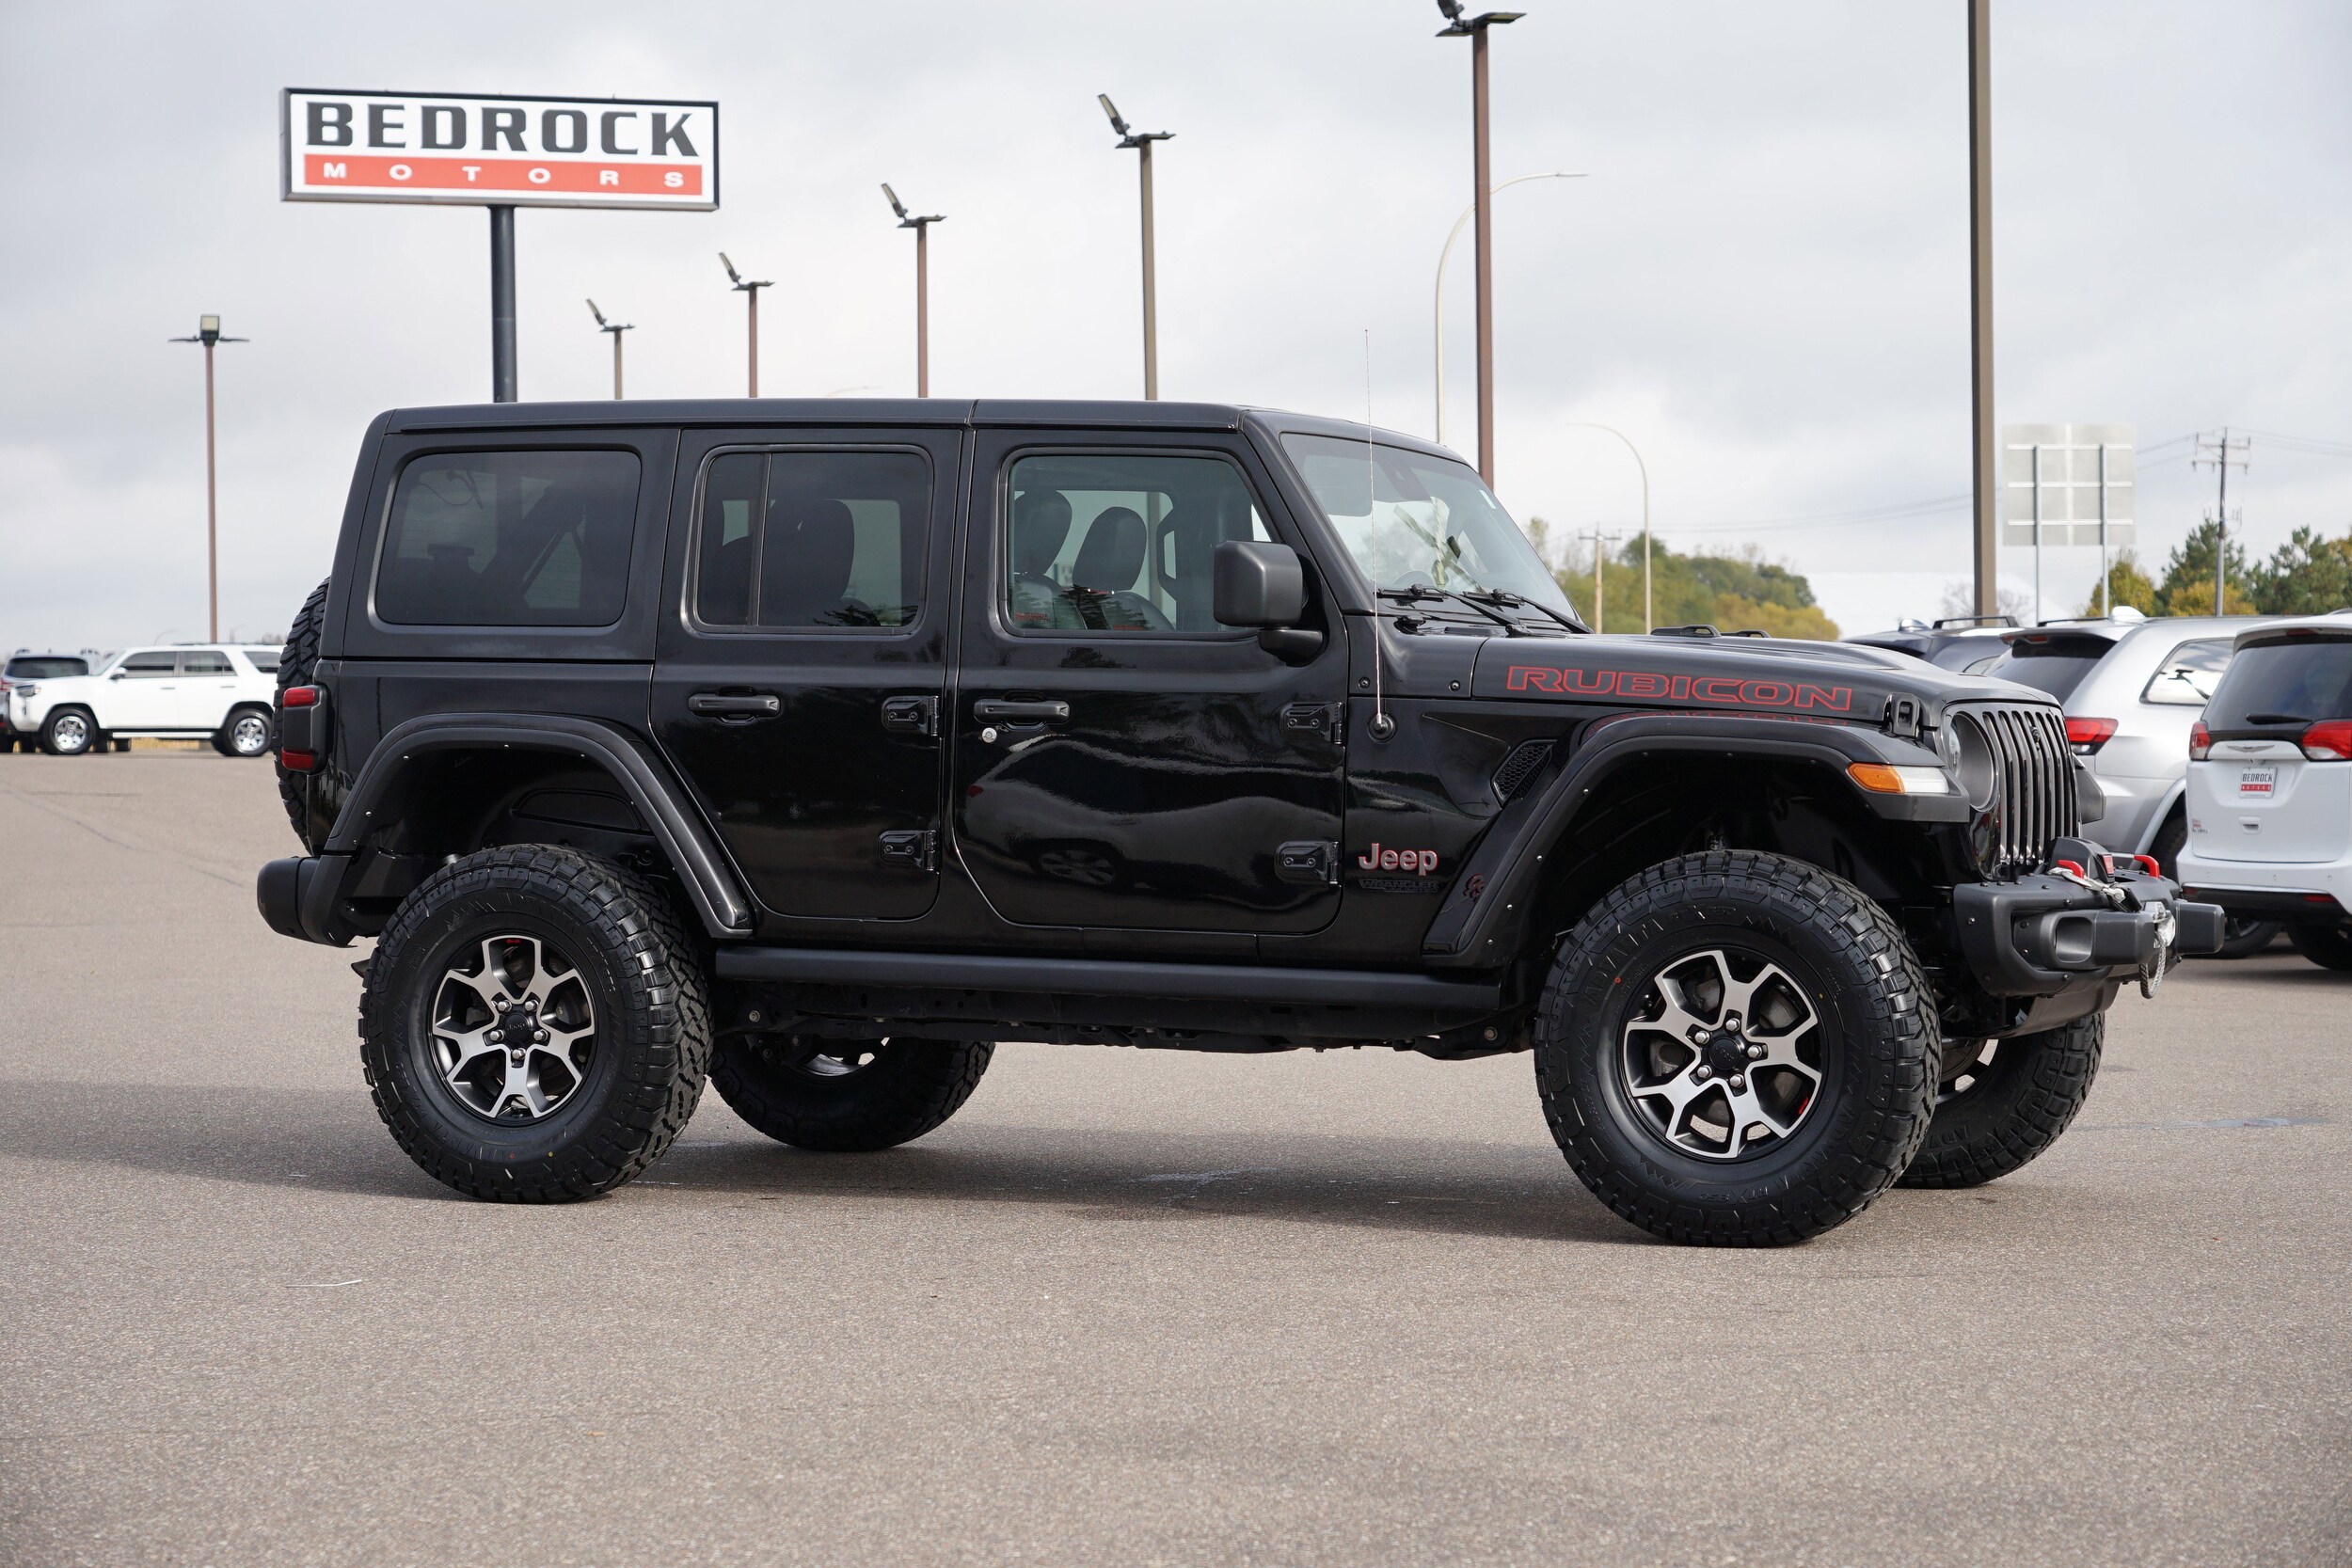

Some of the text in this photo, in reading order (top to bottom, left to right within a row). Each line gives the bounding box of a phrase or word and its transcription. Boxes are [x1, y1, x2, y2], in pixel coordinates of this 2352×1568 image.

[306, 102, 699, 157] BEDROCK
[323, 162, 684, 188] MOTORS
[1506, 665, 1852, 711] RUBICON
[2242, 773, 2273, 782] BEDROCK
[1358, 841, 1438, 877] Jeep
[1360, 879, 1439, 889] WRANGLER
